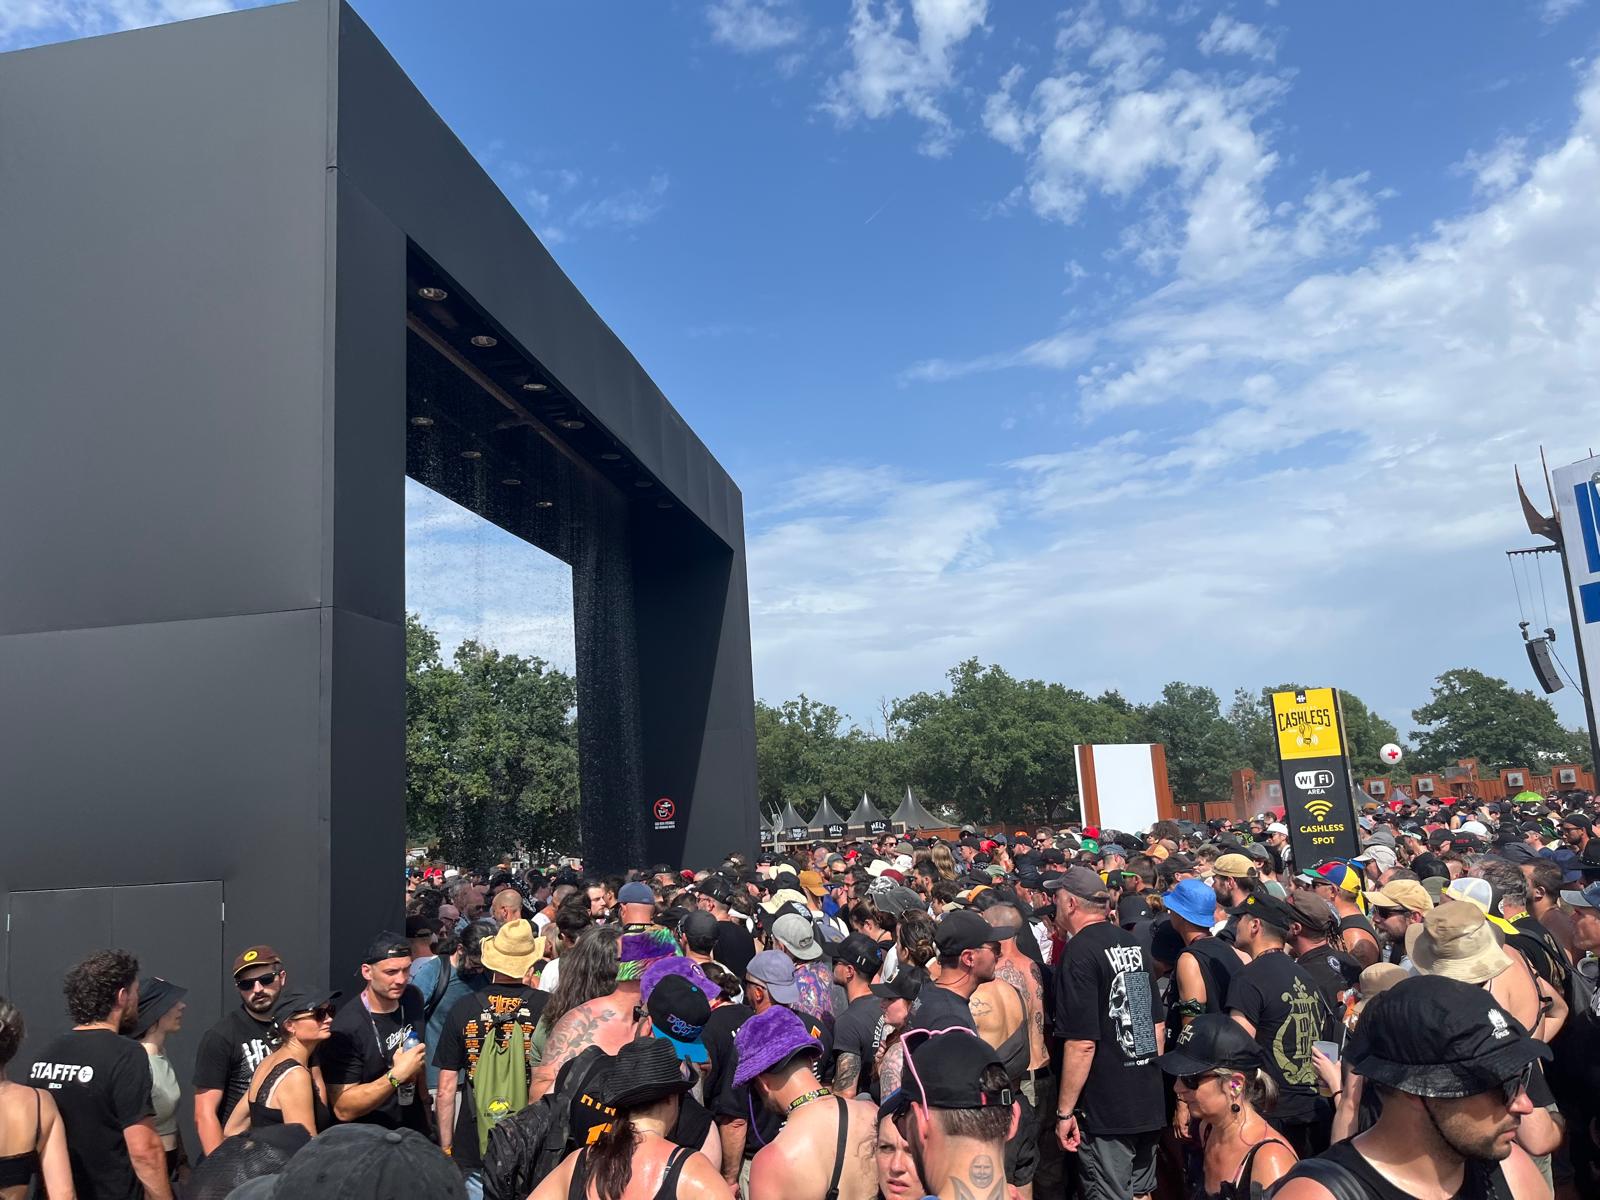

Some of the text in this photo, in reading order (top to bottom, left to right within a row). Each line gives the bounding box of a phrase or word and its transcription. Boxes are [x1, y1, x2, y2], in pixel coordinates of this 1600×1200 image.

[1278, 708, 1331, 732] CASHLESS
[829, 825, 843, 833] MELT
[871, 821, 886, 831] MELT
[1300, 823, 1344, 833] CASHLESS
[1312, 836, 1335, 845] SPOT
